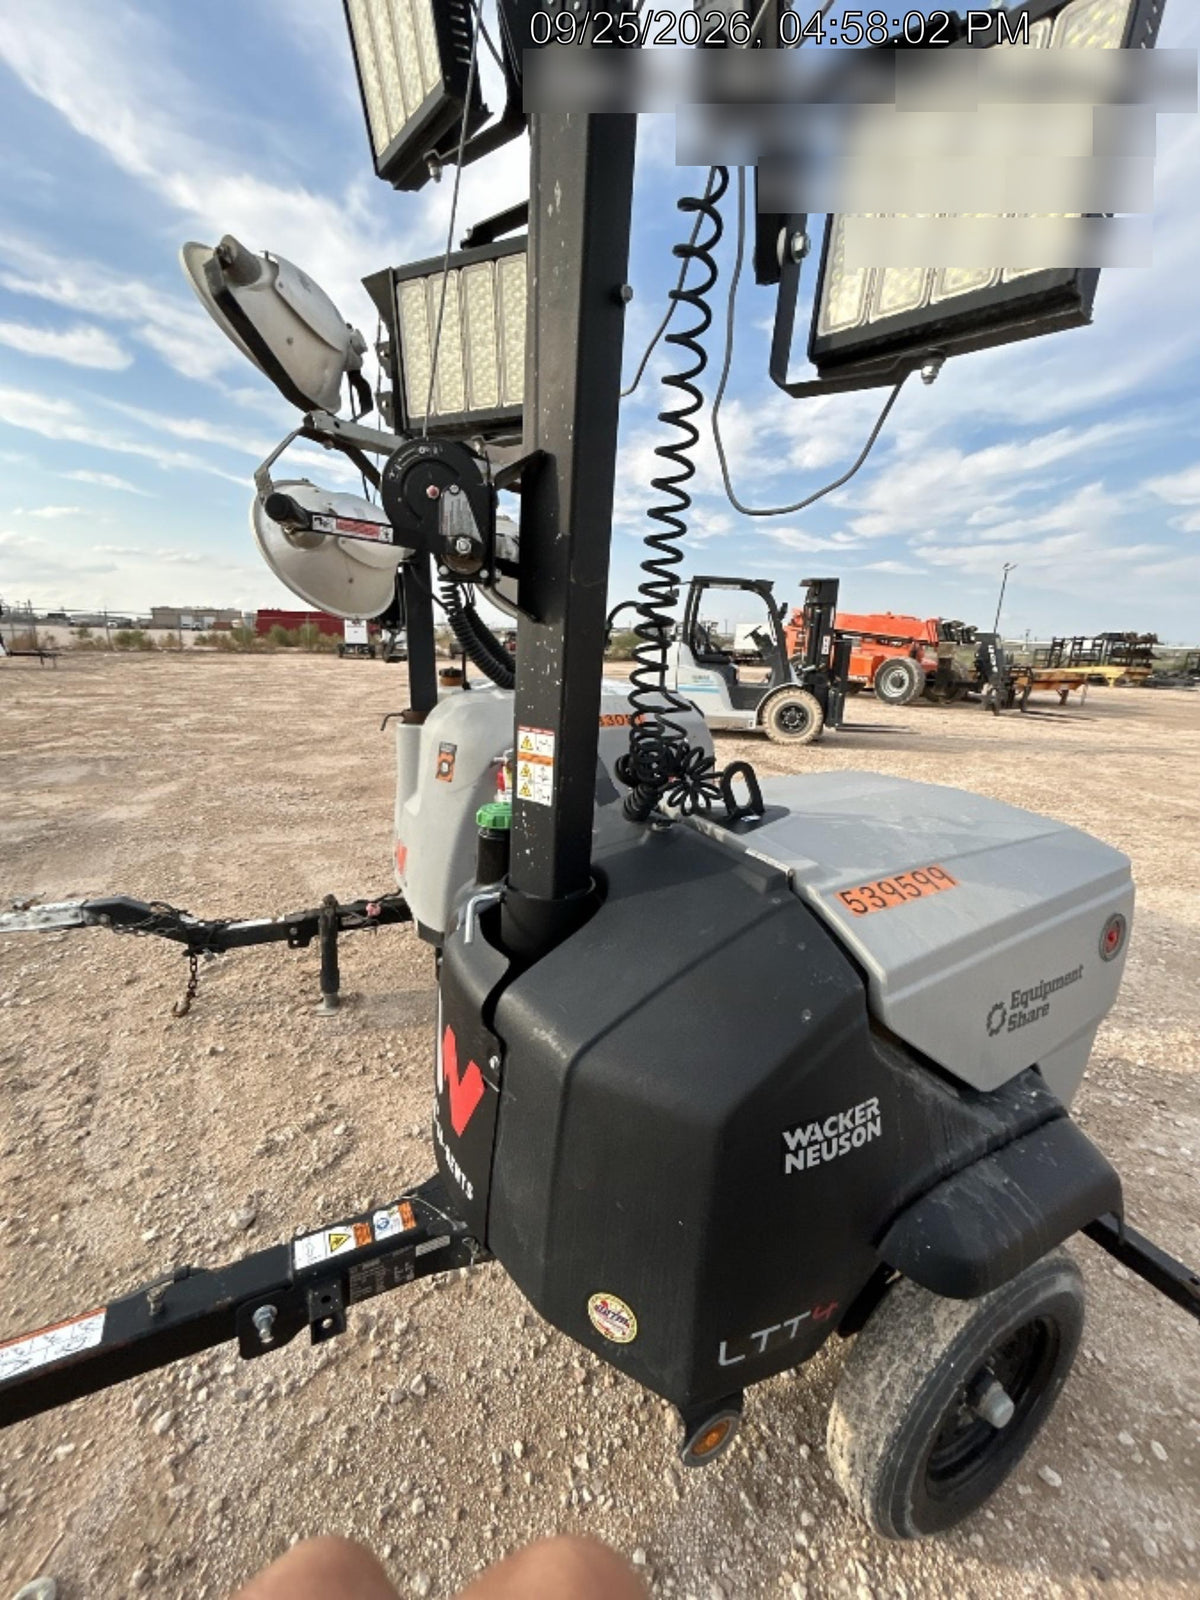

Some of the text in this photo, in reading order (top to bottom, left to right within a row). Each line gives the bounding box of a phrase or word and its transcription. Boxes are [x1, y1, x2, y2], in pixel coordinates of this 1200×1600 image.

[839, 866, 956, 915] 539599
[1010, 964, 1084, 1010] Equipment
[1007, 1003, 1050, 1033] Share
[782, 1096, 881, 1151] WACKER
[785, 1116, 882, 1174] NEUSON
